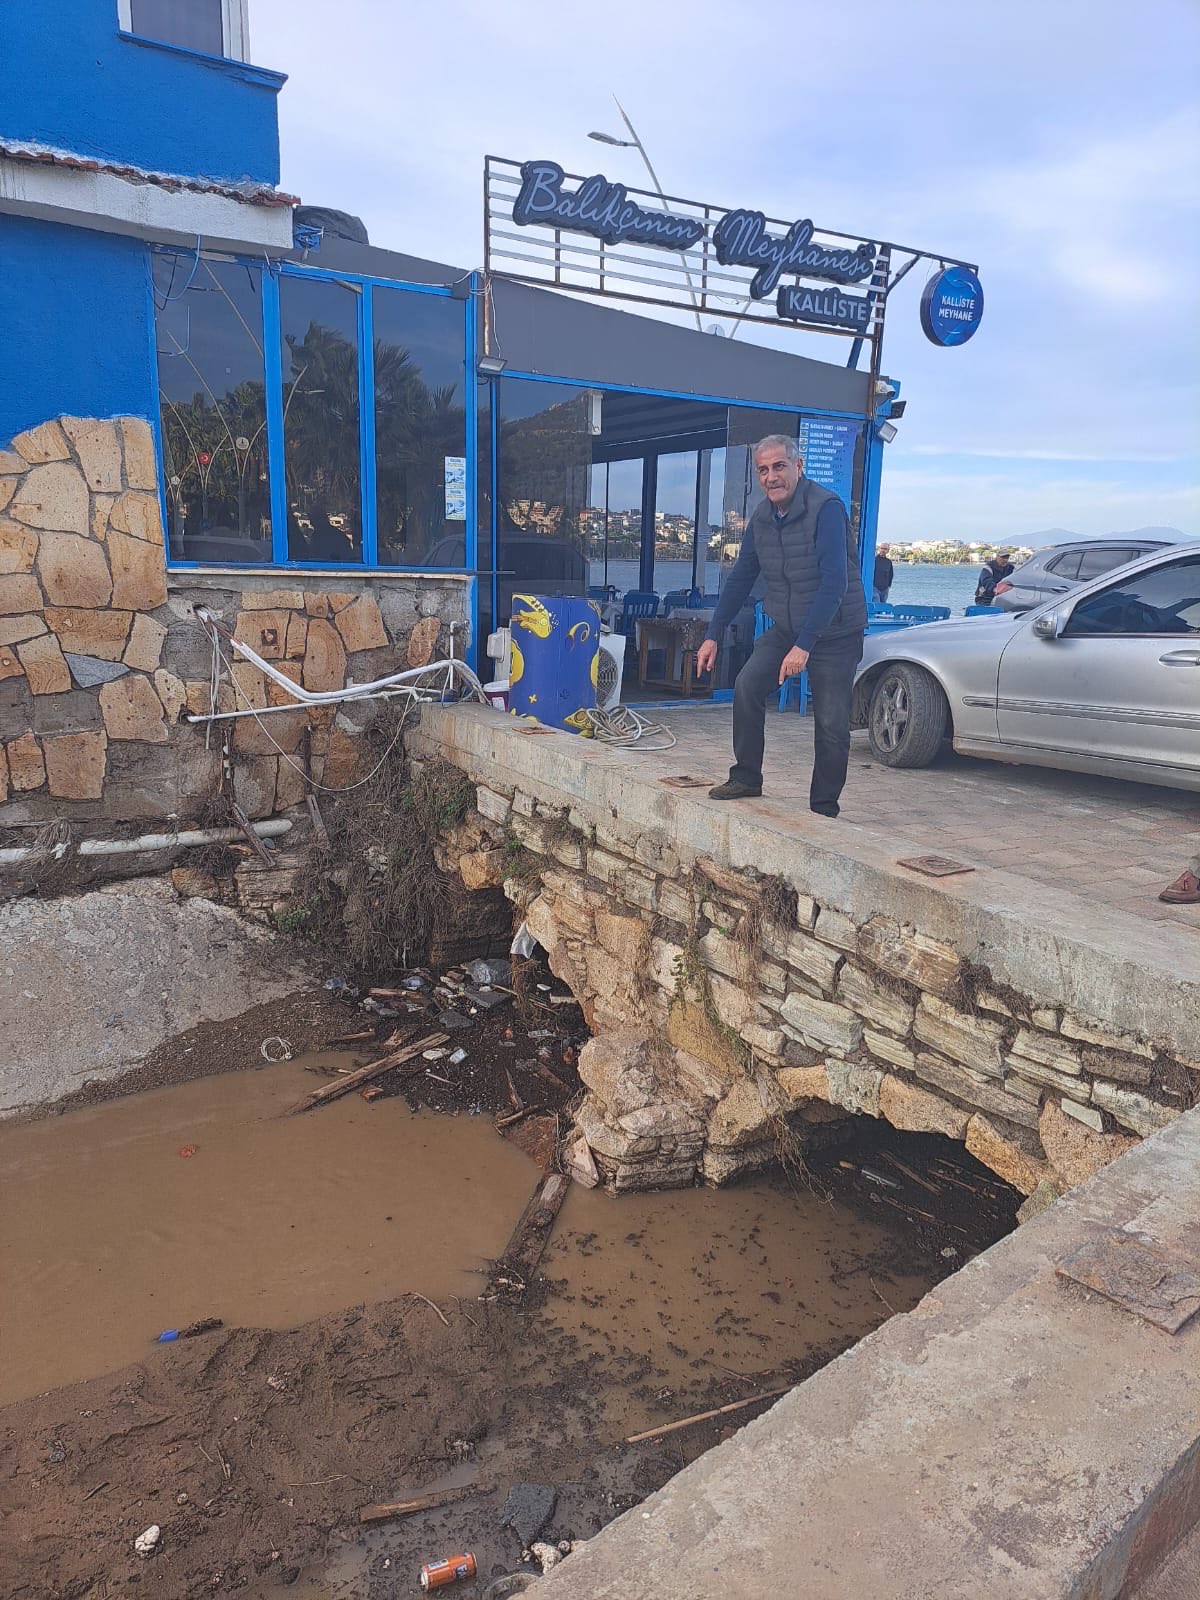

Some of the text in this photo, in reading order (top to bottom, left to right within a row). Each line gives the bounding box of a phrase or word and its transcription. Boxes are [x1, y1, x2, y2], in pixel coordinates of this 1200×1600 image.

[524, 166, 873, 292] Balıkçının Meyhanesi
[788, 290, 867, 321] KALLİSTE
[941, 295, 975, 309] KALLİSTE
[938, 308, 974, 321] MEYHANE
